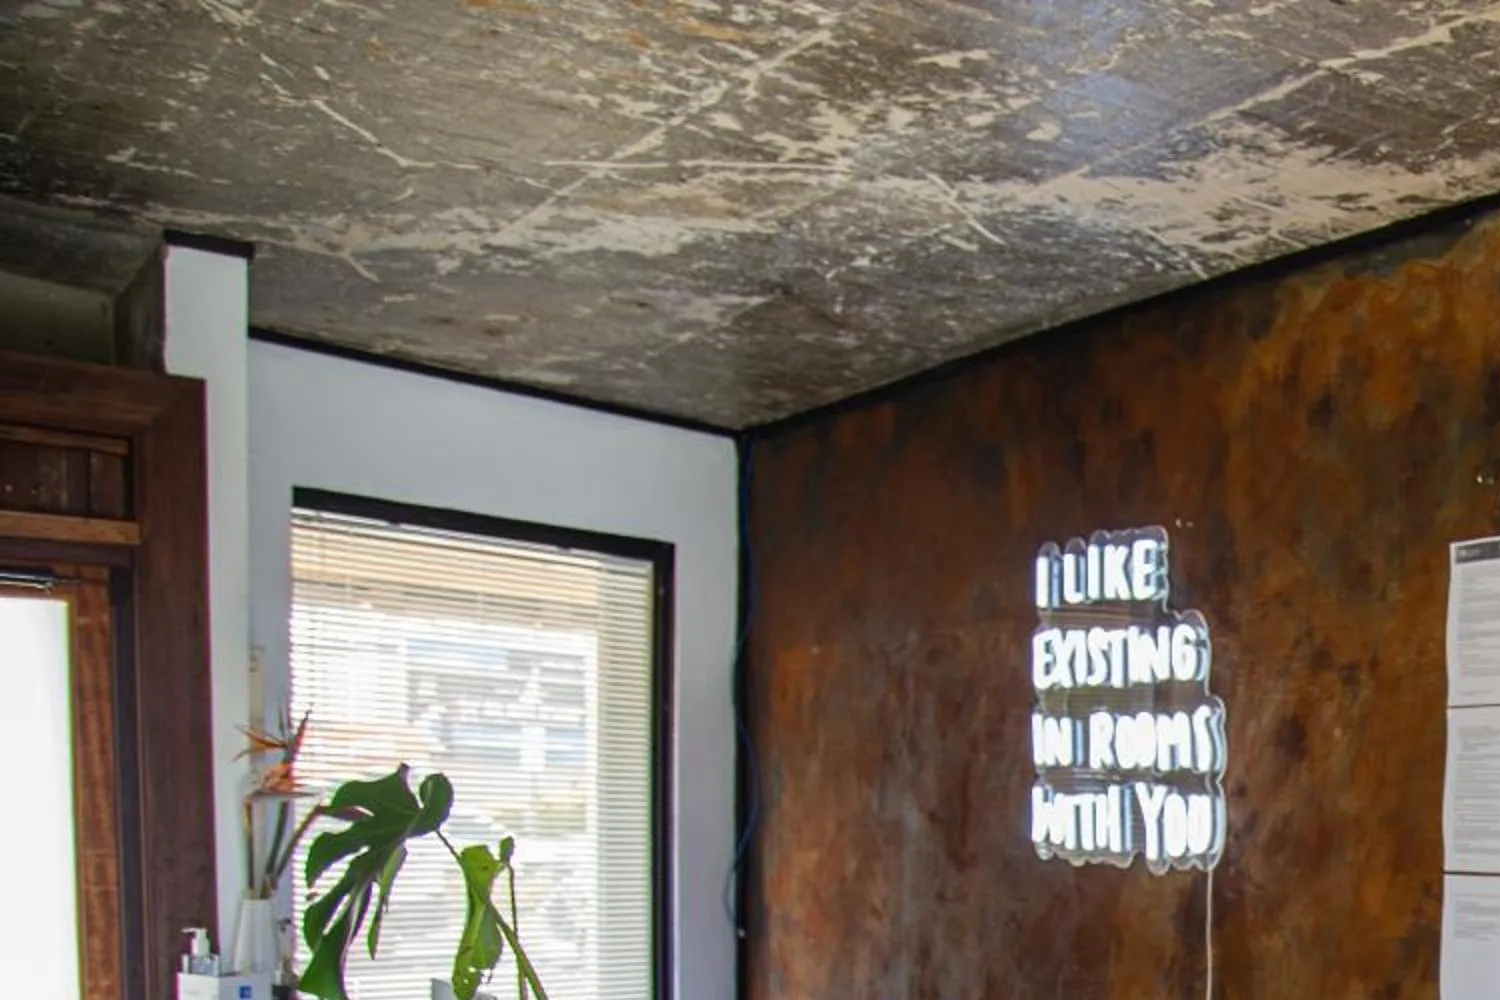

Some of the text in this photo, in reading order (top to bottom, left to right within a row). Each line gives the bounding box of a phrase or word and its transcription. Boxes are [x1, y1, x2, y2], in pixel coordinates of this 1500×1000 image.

[1035, 539, 1158, 608] I LIKE
[1032, 624, 1198, 690] EXISTING
[1031, 705, 1213, 772] IN ROOMS
[1031, 781, 1214, 861] WITH YOU
